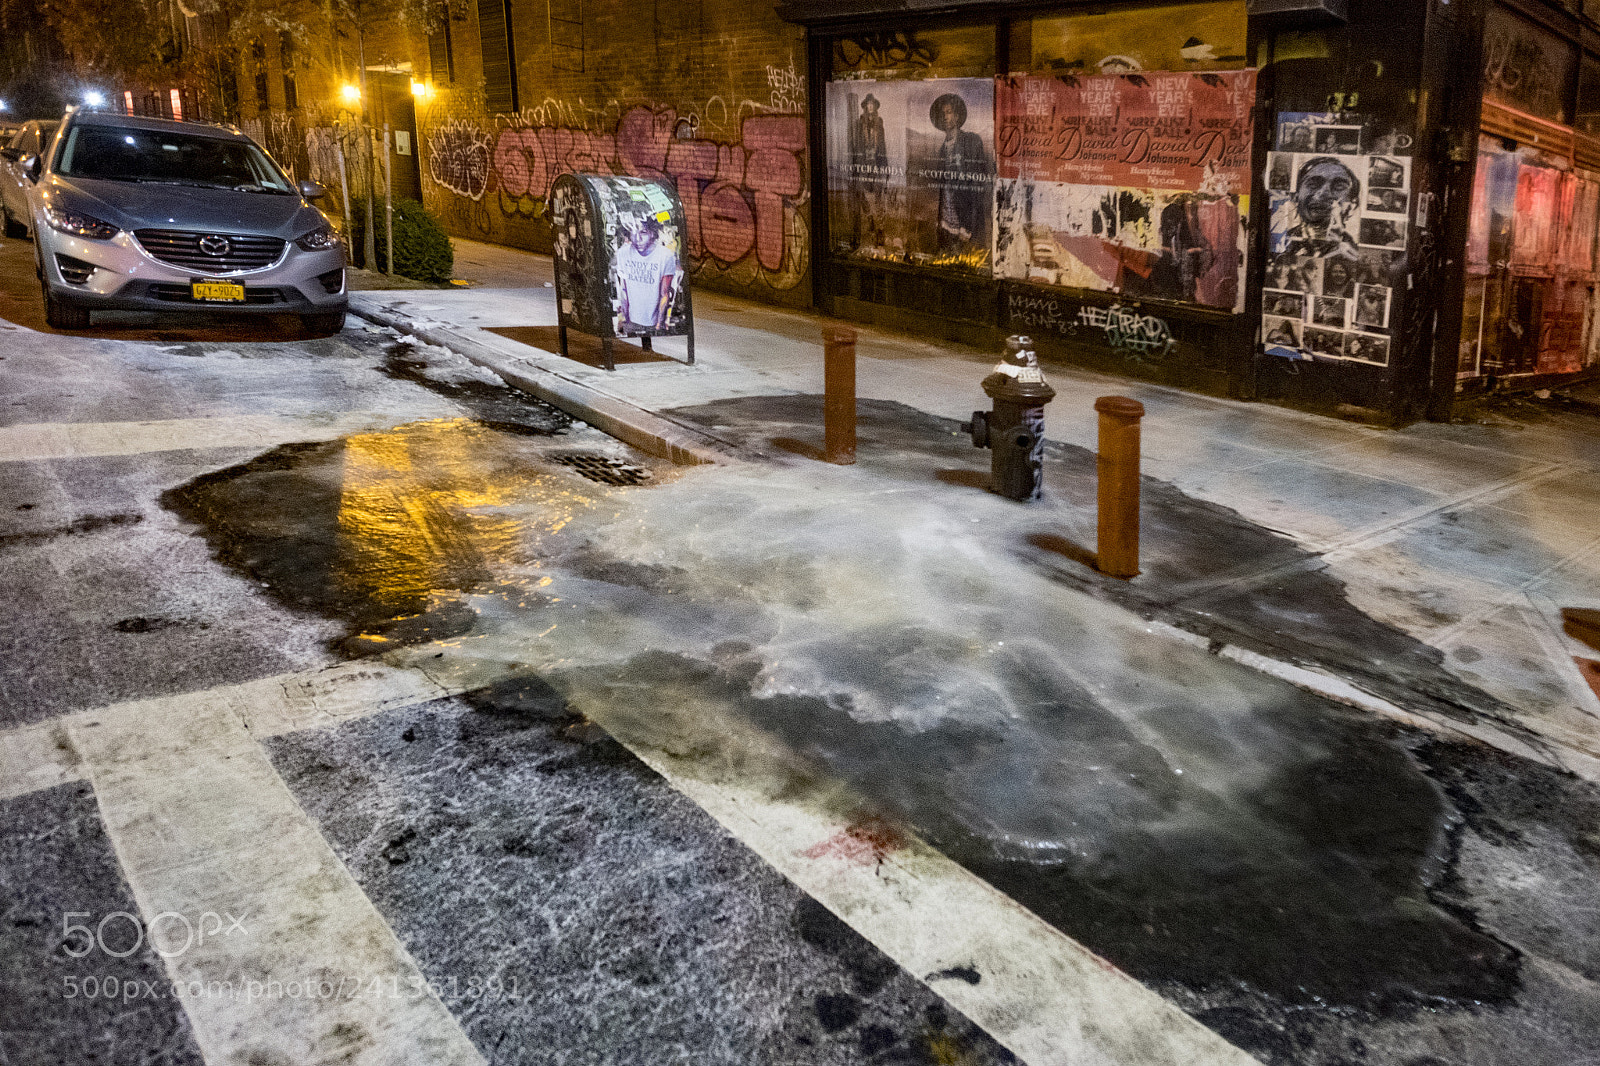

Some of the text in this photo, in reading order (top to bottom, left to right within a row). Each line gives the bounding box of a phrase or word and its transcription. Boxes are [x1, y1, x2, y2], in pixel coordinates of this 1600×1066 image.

[1024, 80, 1050, 92] NEW
[1087, 79, 1116, 91] NEW
[1156, 78, 1189, 91] NEW
[1019, 92, 1057, 104] YEAR'S
[1080, 91, 1122, 104] YEAR'S
[1148, 90, 1194, 105] YEAR'S
[1026, 104, 1050, 116] EVE
[1090, 103, 1113, 116] EVE
[1158, 103, 1185, 117] EVE
[1127, 116, 1186, 127] SURREALIST
[1000, 126, 1054, 157] David
[1055, 127, 1118, 161] David
[1119, 128, 1192, 164] David
[650, 263, 658, 271] IS
[628, 273, 655, 285] RATED
